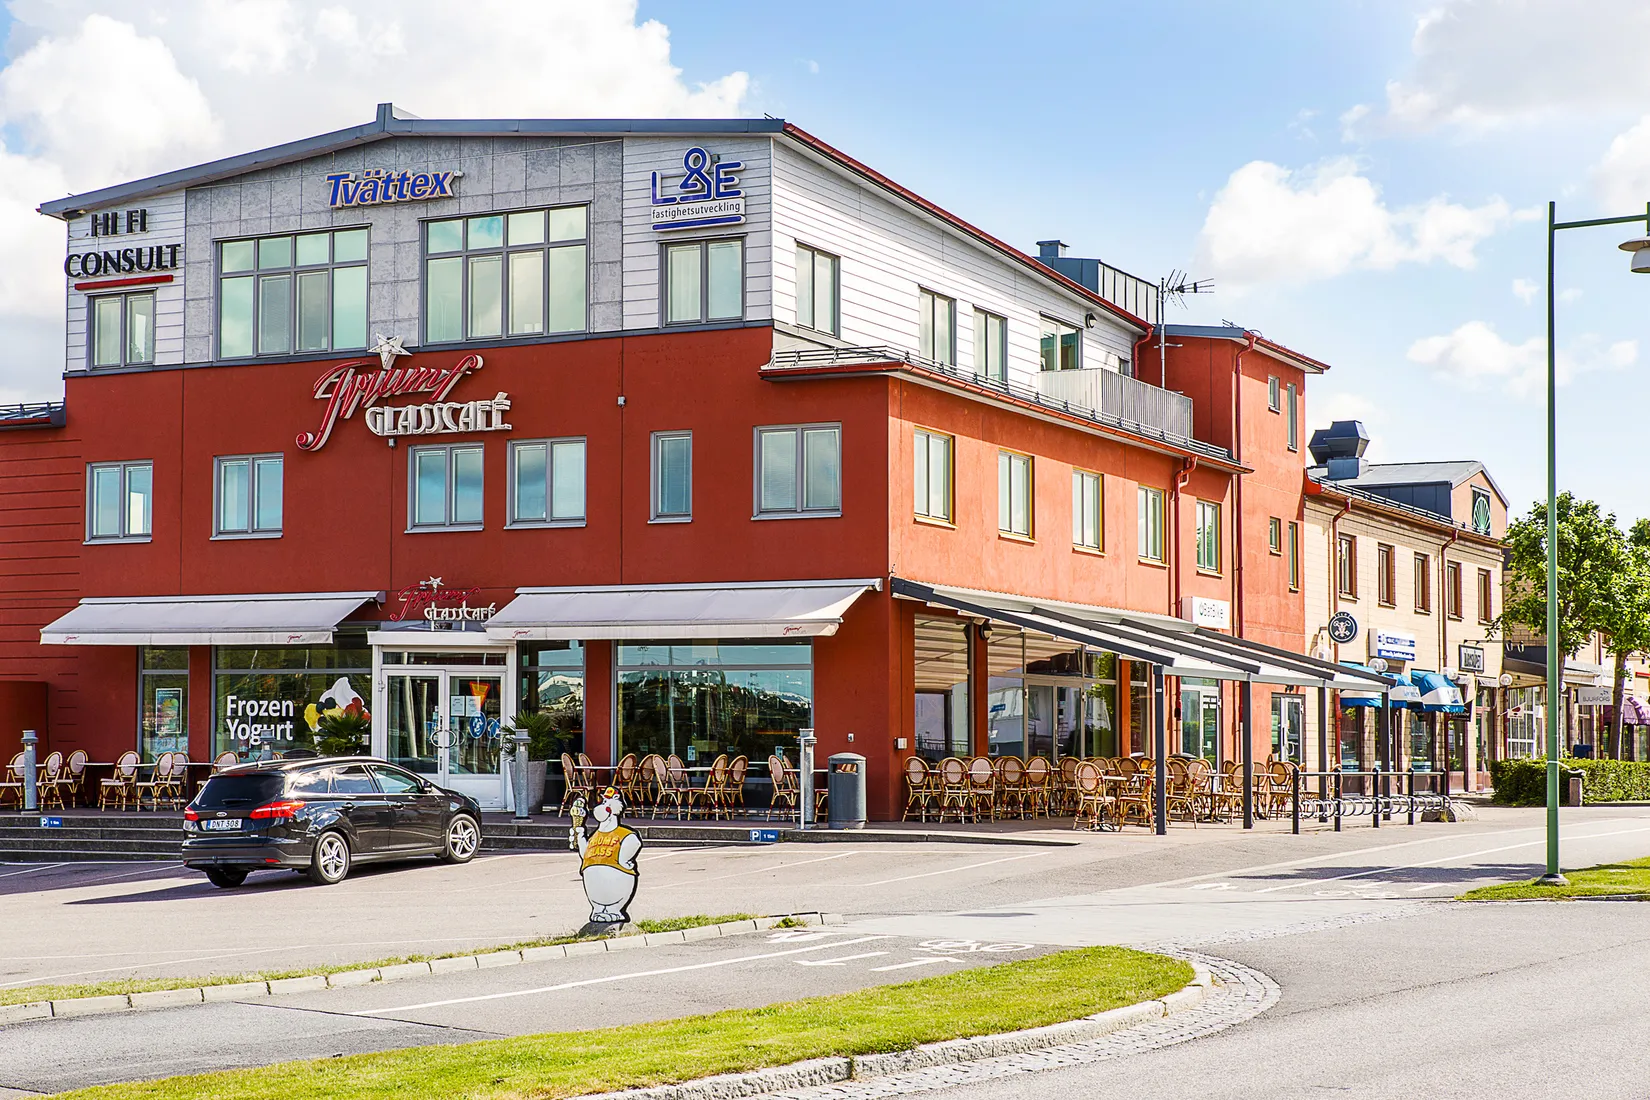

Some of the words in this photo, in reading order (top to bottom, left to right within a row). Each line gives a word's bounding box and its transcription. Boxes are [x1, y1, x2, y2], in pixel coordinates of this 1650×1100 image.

[326, 168, 454, 208] Tvättex
[651, 147, 746, 206] L&E
[91, 211, 118, 237] HI
[126, 209, 147, 233] FI
[652, 202, 740, 219] fastighetsutveckling
[64, 244, 181, 278] CONSULT
[365, 391, 512, 436] GLASSCAFÉ
[226, 695, 294, 717] Frozen
